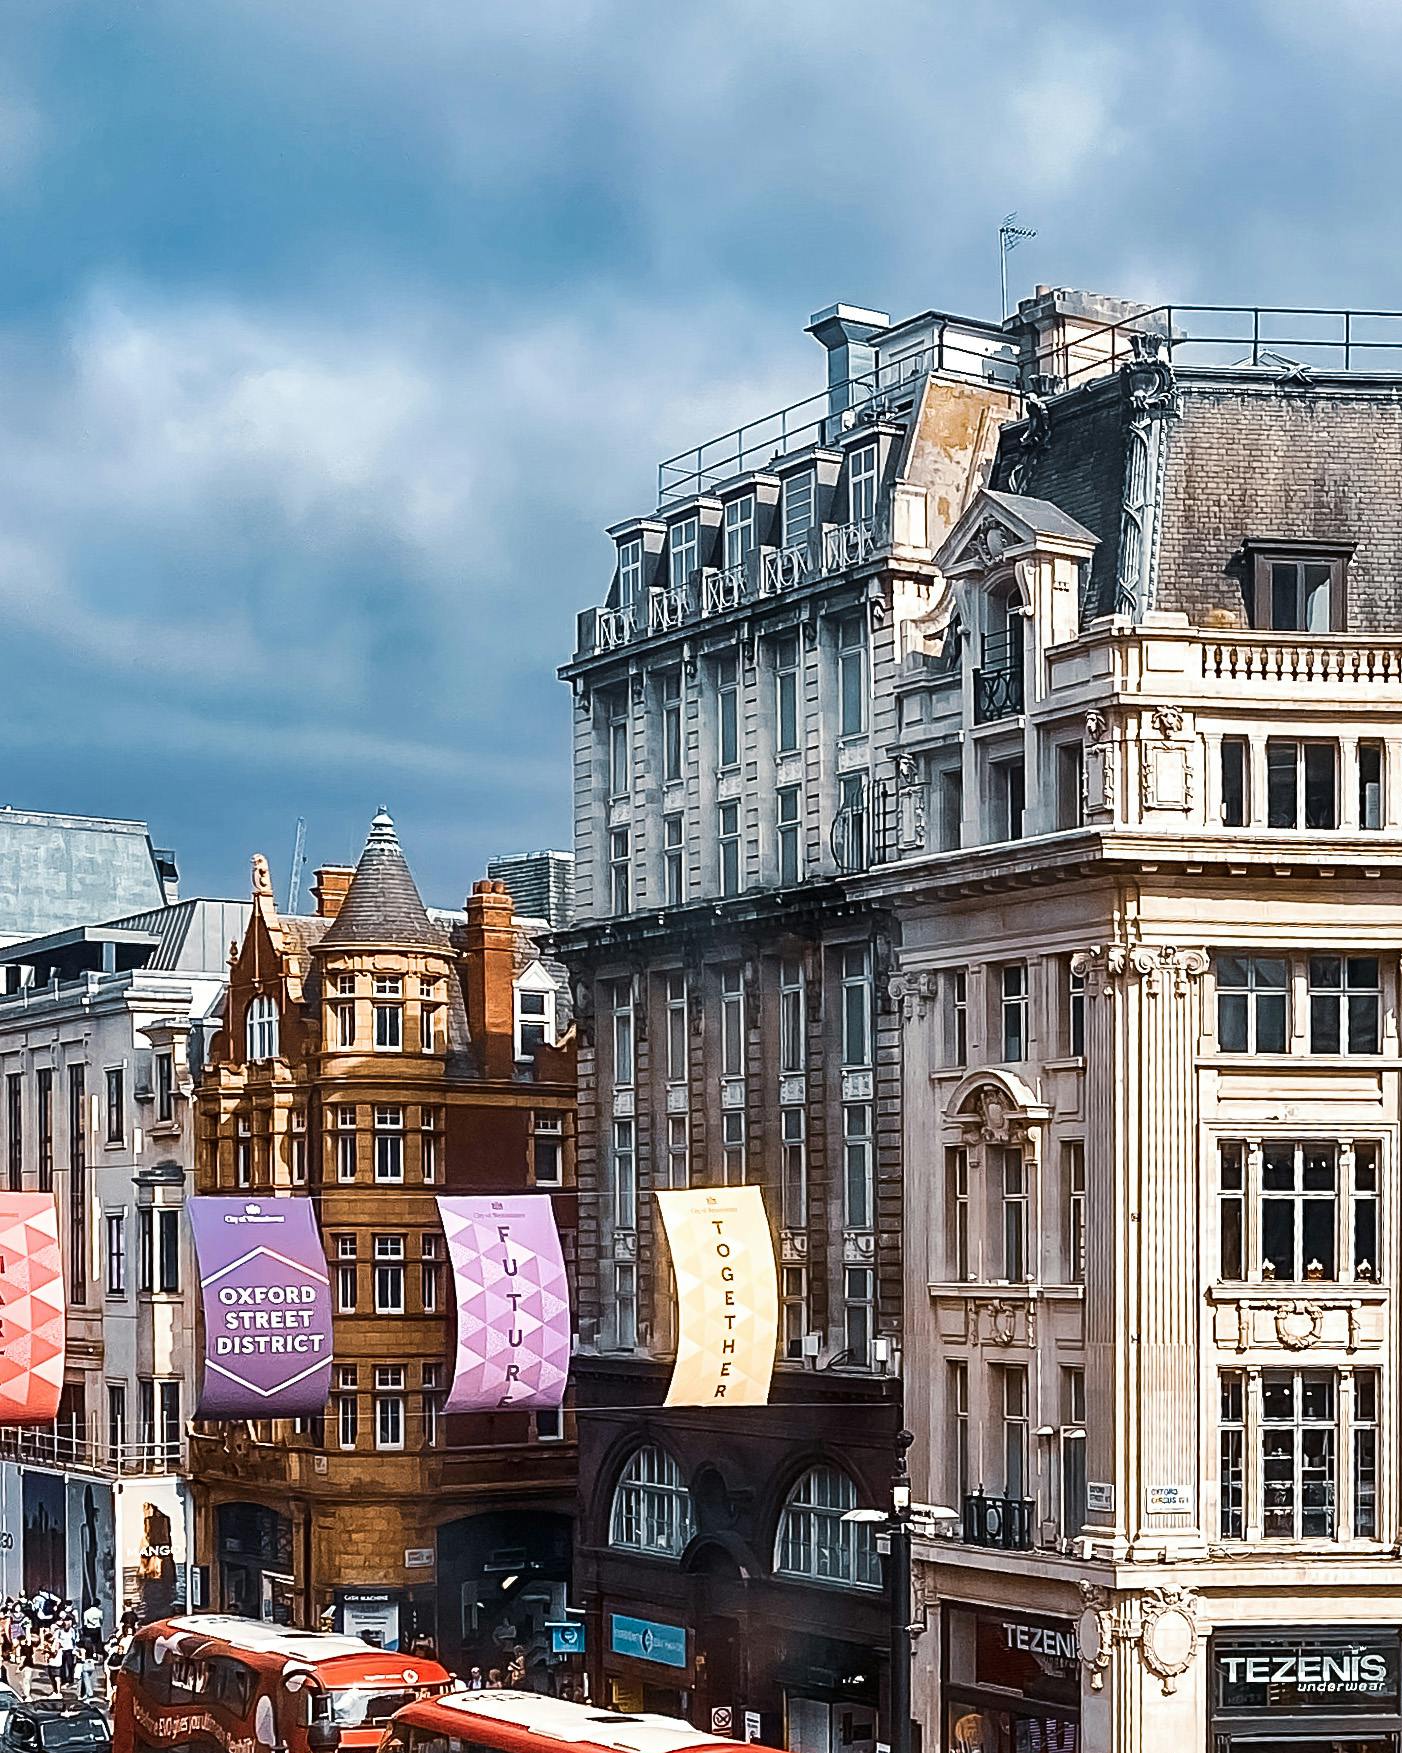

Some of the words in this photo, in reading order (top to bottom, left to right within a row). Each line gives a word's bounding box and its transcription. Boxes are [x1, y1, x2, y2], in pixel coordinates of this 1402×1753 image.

[218, 1286, 317, 1305] OXFORD
[225, 1310, 314, 1329] STREET
[711, 1221, 736, 1398] TOGETHER
[216, 1334, 325, 1355] DISTRICT
[1002, 1622, 1077, 1659] TEZENI
[1220, 1651, 1387, 1684] TEZENIS
[1297, 1682, 1387, 1693] underwear
